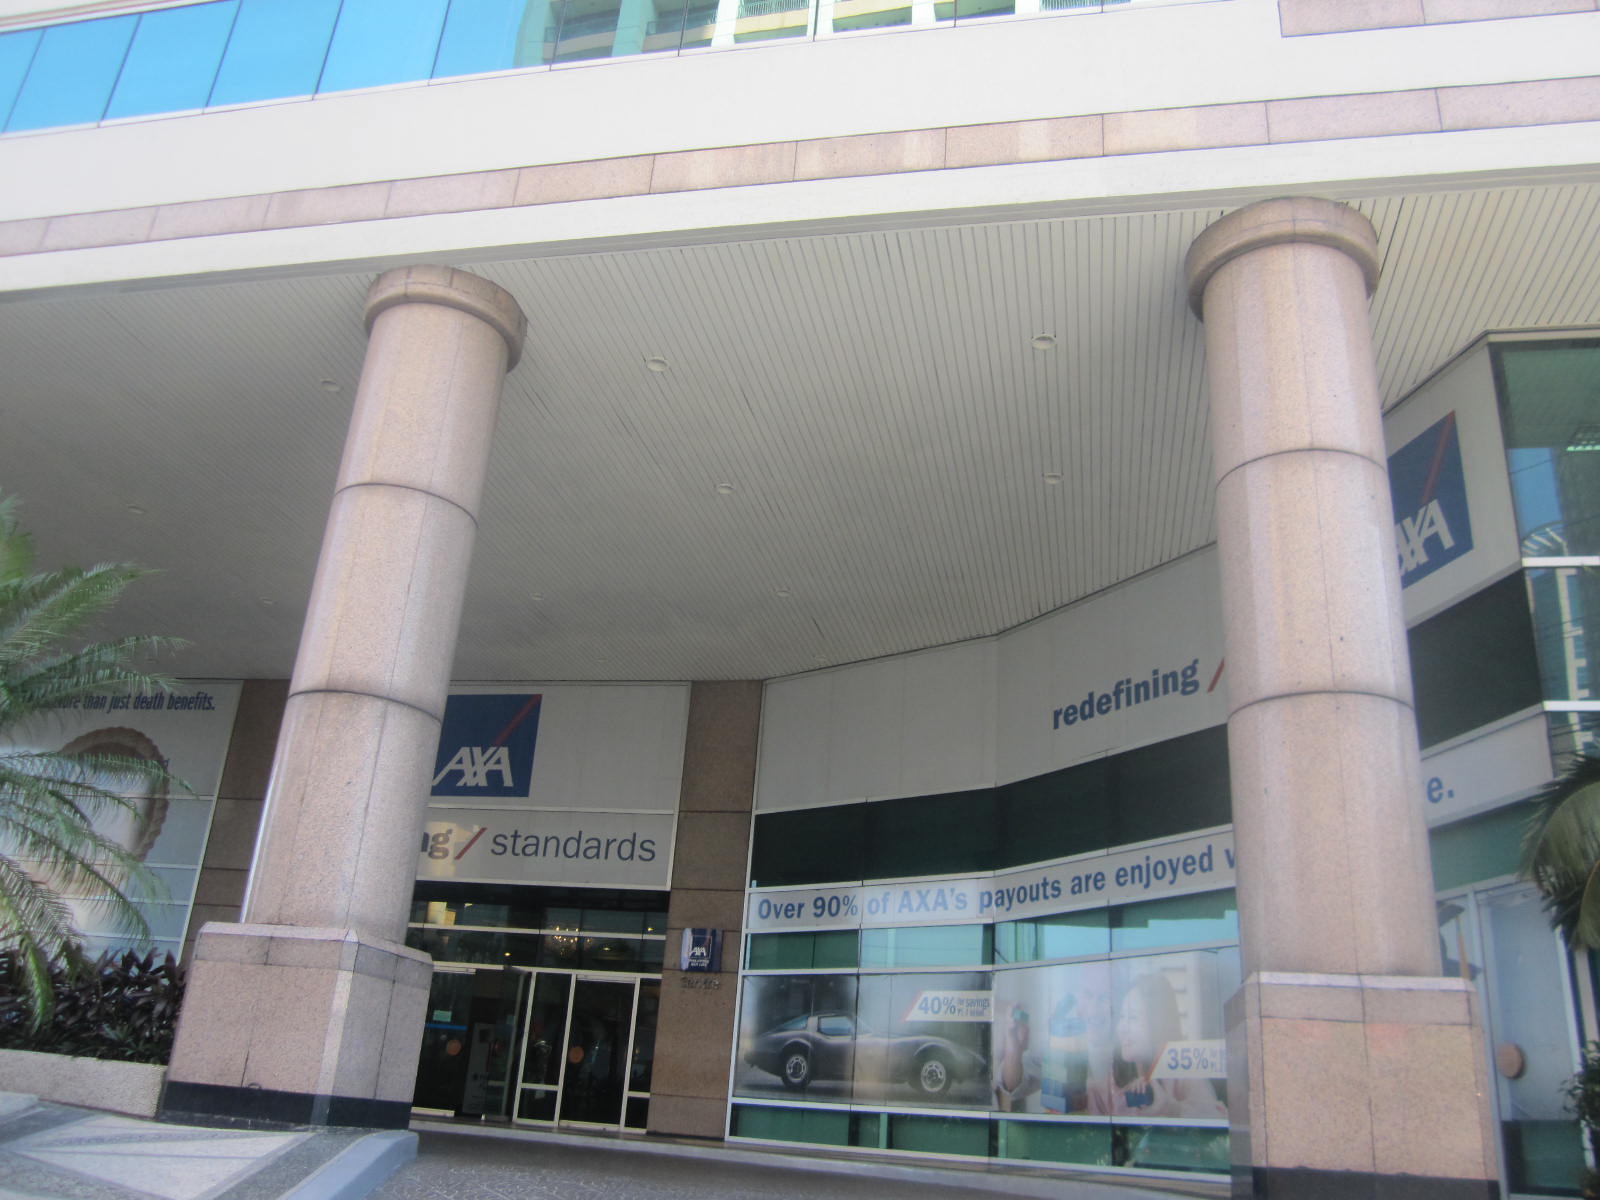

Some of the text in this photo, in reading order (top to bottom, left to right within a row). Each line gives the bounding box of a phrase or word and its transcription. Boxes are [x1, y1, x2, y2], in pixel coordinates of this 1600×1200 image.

[107, 693, 131, 714] just
[134, 692, 164, 711] death
[167, 691, 215, 711] benefits.
[1052, 657, 1200, 730] redefining
[431, 746, 514, 787] AXA
[491, 829, 657, 863] standards
[757, 897, 805, 920] Over
[811, 894, 859, 919] 90%
[866, 891, 891, 915] of
[897, 887, 968, 914] AXA's
[978, 876, 1062, 915] payouts
[1070, 870, 1106, 896] are
[1115, 843, 1214, 889] enjoyed
[917, 996, 957, 1016] 40%
[1167, 1047, 1209, 1071] 35%
